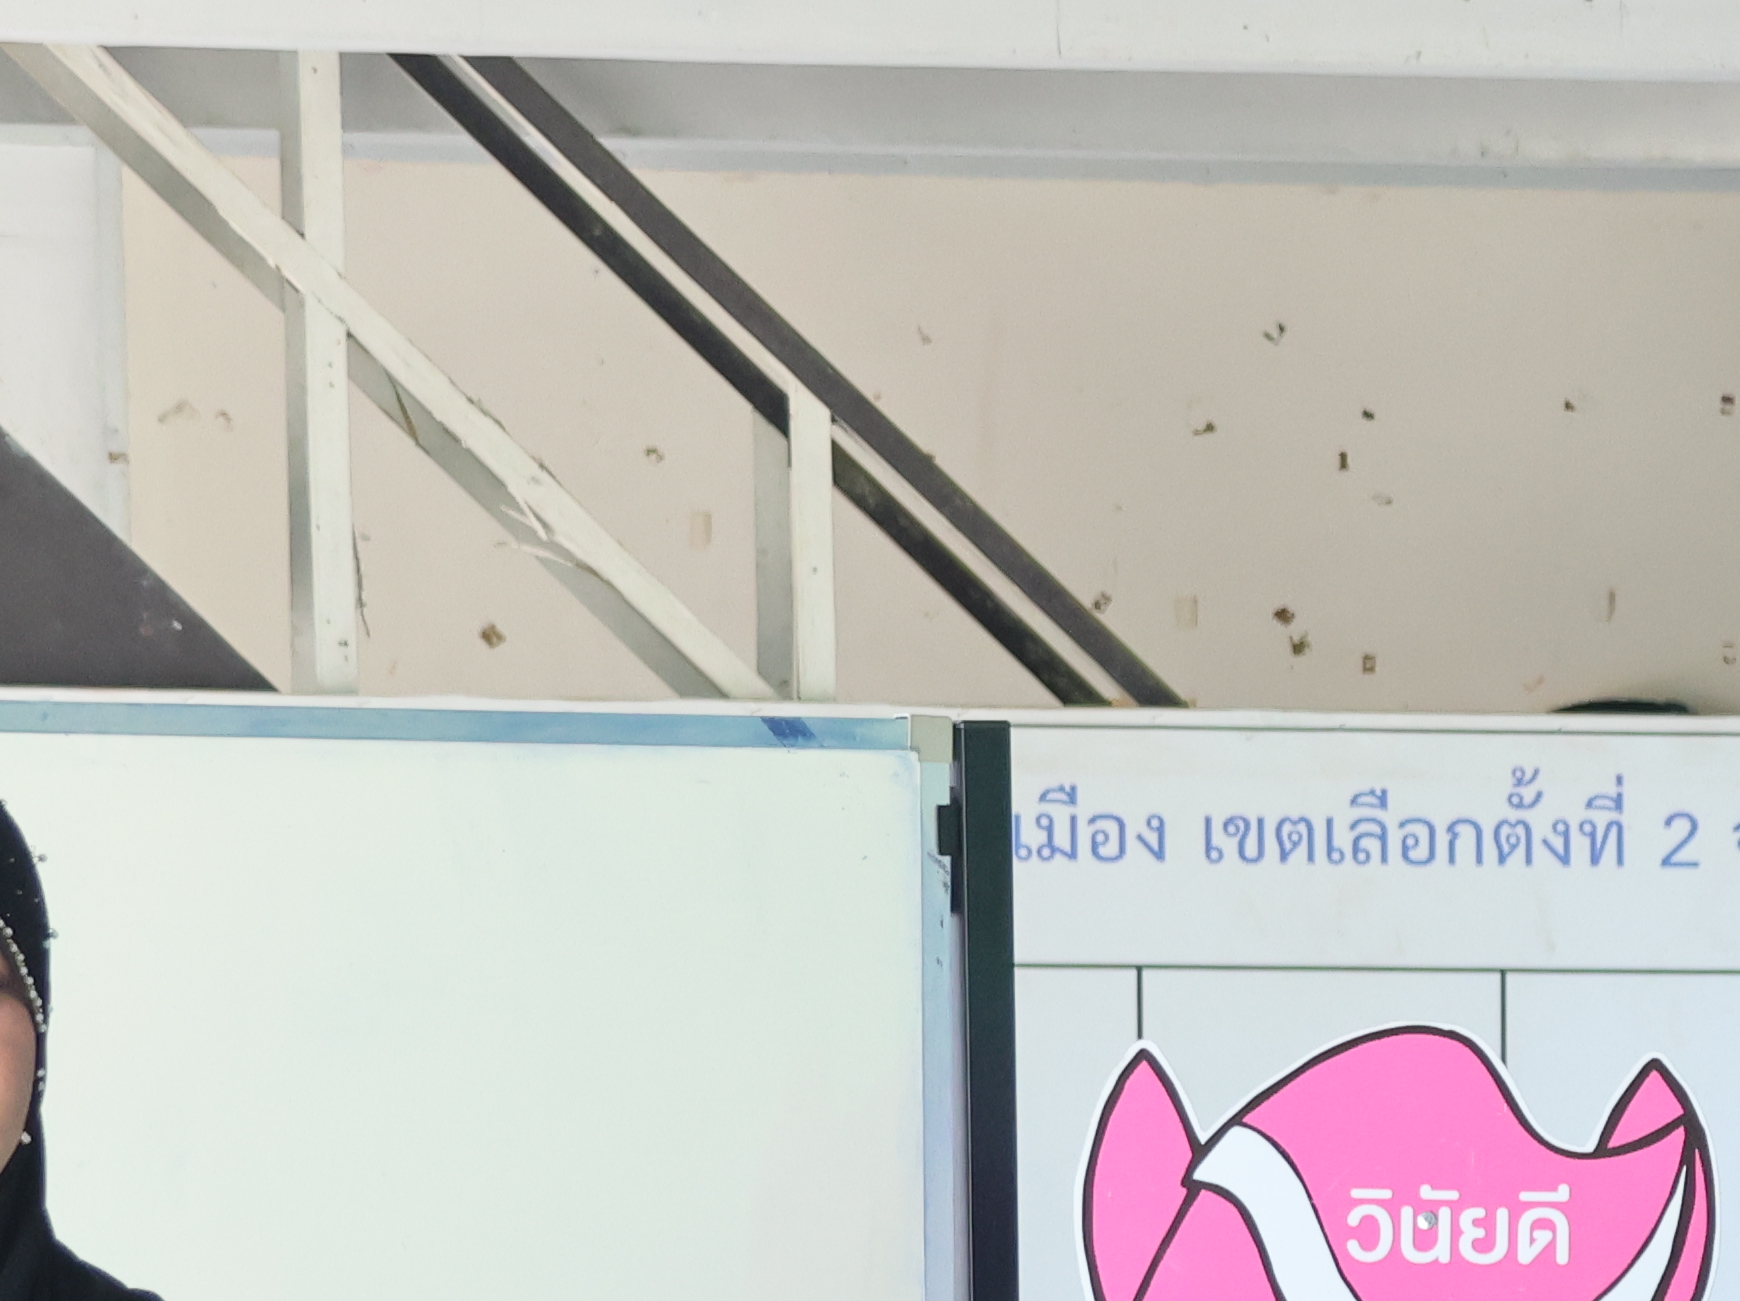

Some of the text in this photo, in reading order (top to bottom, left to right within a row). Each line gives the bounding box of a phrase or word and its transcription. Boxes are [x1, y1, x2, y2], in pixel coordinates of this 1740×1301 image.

[1204, 764, 1625, 868] เขตเลือกตั้งที่
[1659, 811, 1701, 869] 2
[1346, 1182, 1573, 1266] วินัยดี
